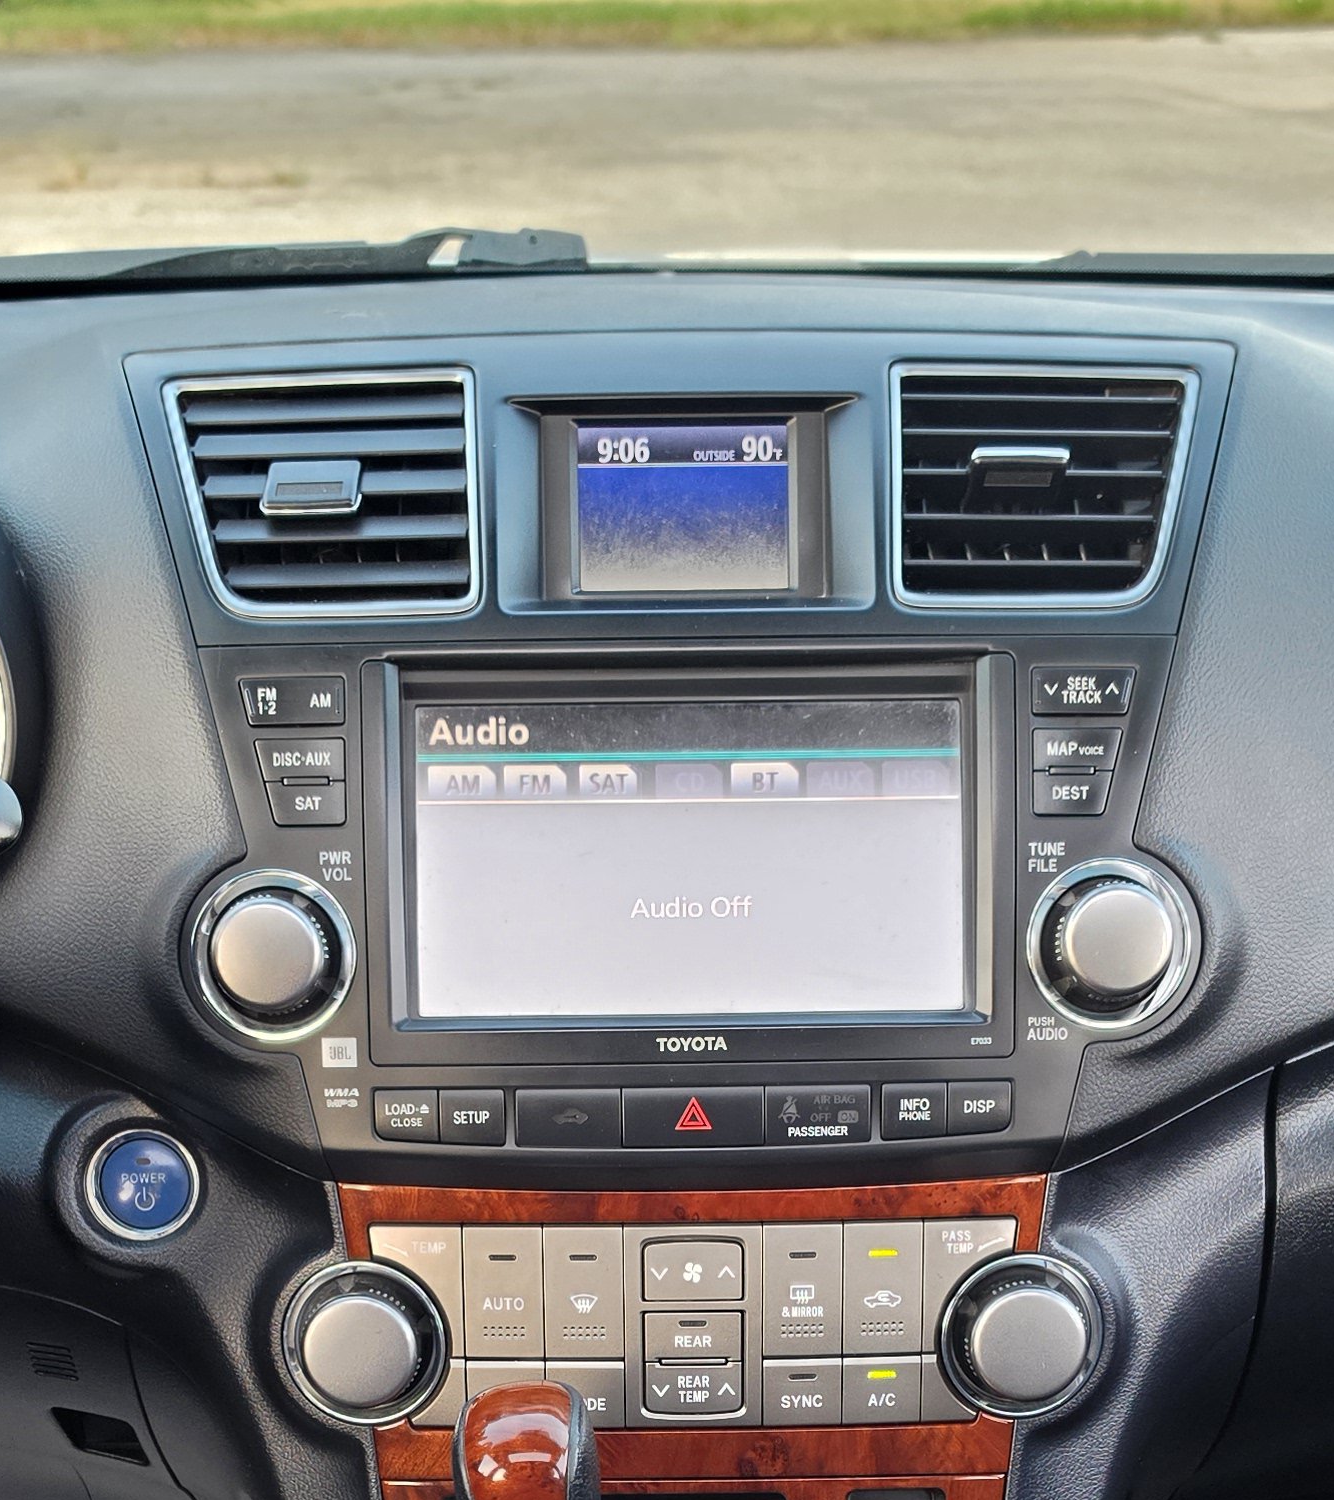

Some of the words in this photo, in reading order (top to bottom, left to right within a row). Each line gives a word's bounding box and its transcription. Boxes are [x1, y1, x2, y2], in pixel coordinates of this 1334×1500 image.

[597, 437, 650, 463] 9:06
[693, 449, 735, 462] OUTSIDE
[1067, 676, 1096, 690] SEEK
[257, 688, 277, 701] FM
[310, 694, 331, 708] AM
[1061, 690, 1102, 704] TRACK
[428, 717, 530, 747] Audio
[1047, 742, 1077, 756] MAP
[1078, 745, 1104, 756] VOICE
[446, 773, 480, 795] AM
[519, 773, 552, 795] FM
[588, 771, 628, 794] SAT
[751, 771, 779, 792] BT
[1052, 786, 1089, 800] DEST
[294, 797, 322, 811] SAT
[1028, 842, 1065, 856] TUNE
[319, 851, 351, 865] PWR
[1028, 858, 1058, 873] FILE
[322, 867, 352, 882] VOL
[630, 897, 704, 919] Audio
[711, 896, 753, 919] Off
[1028, 1017, 1054, 1027] PUSH
[1027, 1027, 1068, 1041] AUDIO
[656, 1037, 727, 1052] TOYOTA
[324, 1088, 360, 1097] WMA
[900, 1098, 930, 1111] INFO
[963, 1100, 995, 1113] DISP
[390, 1117, 423, 1128] CLOSE
[453, 1110, 490, 1125] SETUP
[898, 1110, 931, 1122] PHONE
[787, 1126, 848, 1138] PASSENGER
[121, 1173, 167, 1184] POWER
[942, 1230, 971, 1242] PASS
[411, 1241, 446, 1254] TEMP
[947, 1242, 974, 1254] TEMP
[483, 1297, 525, 1311] AUTO
[791, 1306, 824, 1317] MIRROR
[674, 1335, 712, 1348] REAR
[677, 1375, 709, 1388] REAR
[678, 1390, 709, 1403] TEMP
[780, 1394, 823, 1409] SYNC
[868, 1393, 897, 1408] A/C
